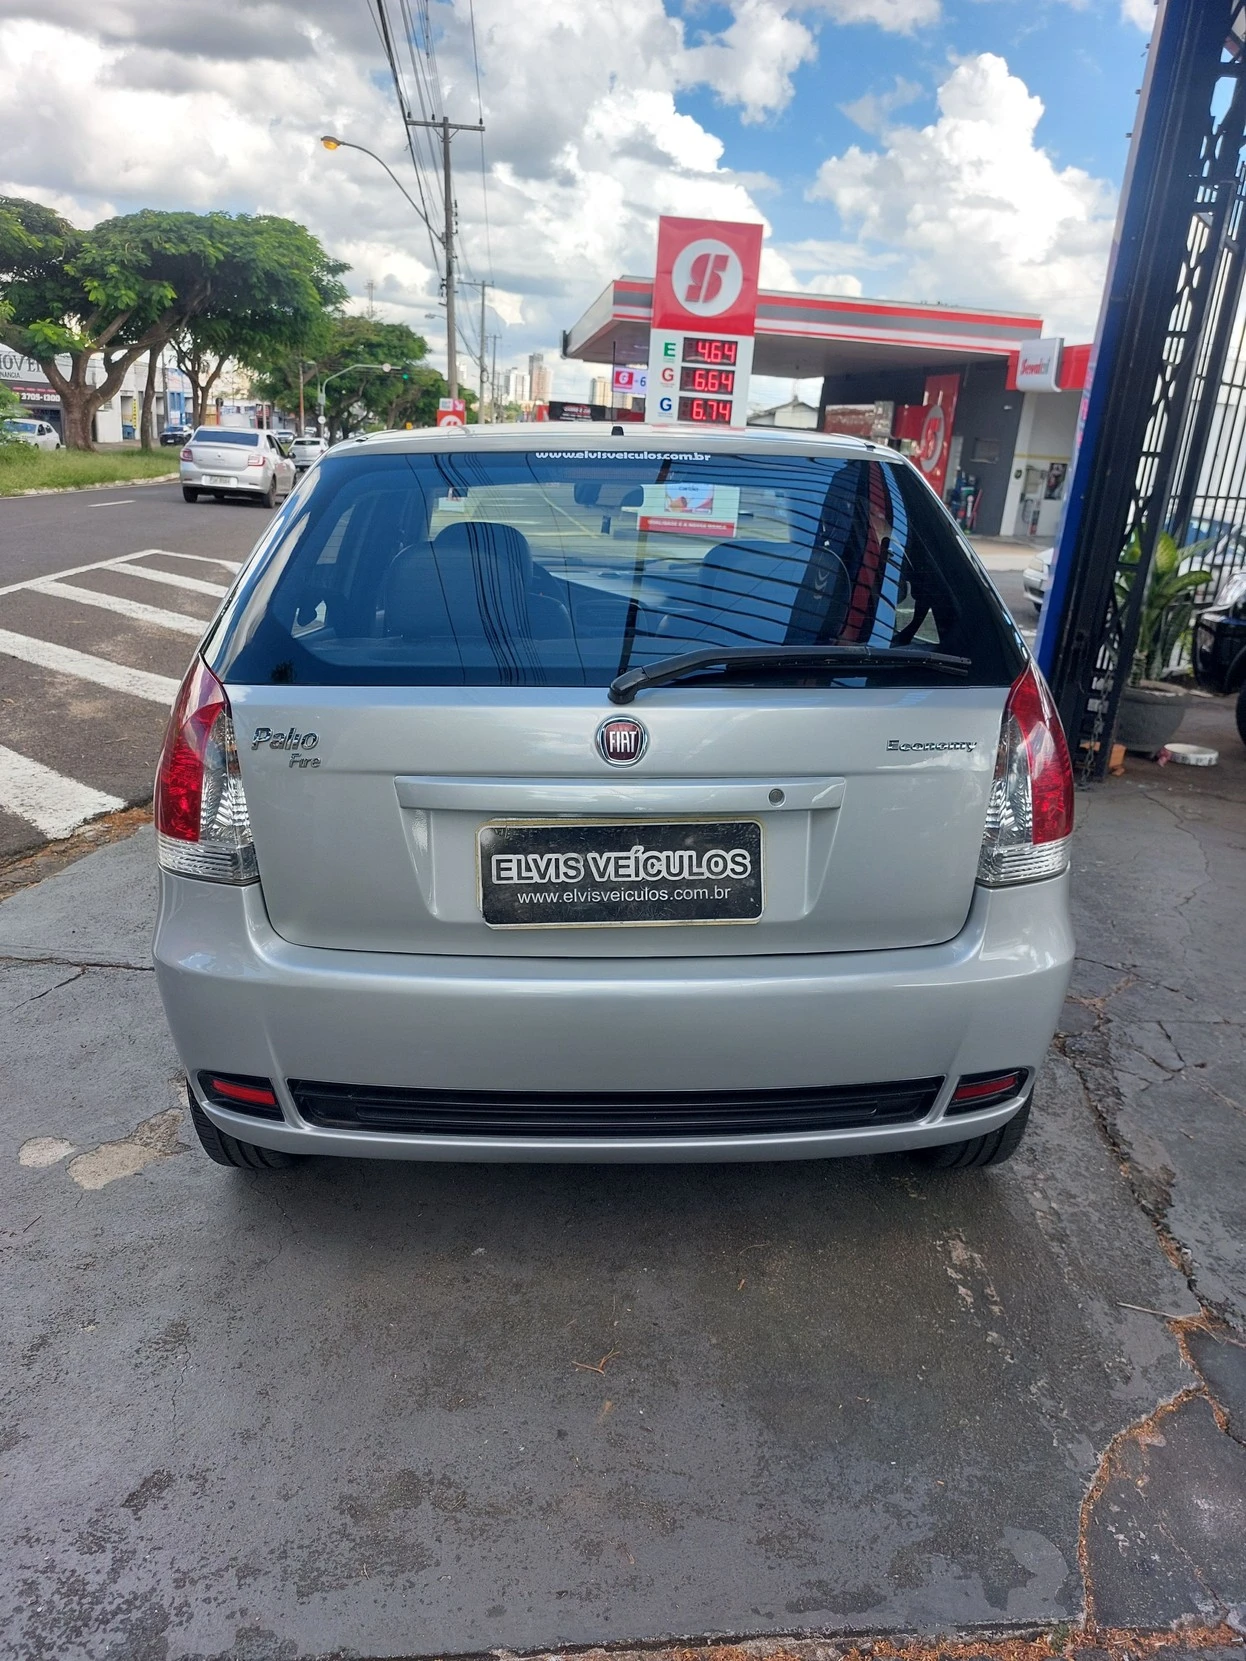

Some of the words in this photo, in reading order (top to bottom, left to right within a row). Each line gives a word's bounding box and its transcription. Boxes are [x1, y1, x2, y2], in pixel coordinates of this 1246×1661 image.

[663, 342, 676, 357] E
[697, 341, 736, 363] 4.64
[662, 367, 674, 382] G
[694, 370, 733, 392] 6.64
[660, 397, 672, 411] G
[692, 399, 730, 421] 6.74
[535, 450, 711, 461] www.elvisveiculos.com.br
[251, 727, 319, 750] Palio
[609, 731, 637, 753] FIAT
[886, 739, 977, 752] Economy
[289, 753, 321, 768] Fire
[492, 853, 585, 885] ELVIS
[587, 845, 752, 883] VEÍCULOS
[517, 885, 732, 904] www.elvisveiculos.com.br
